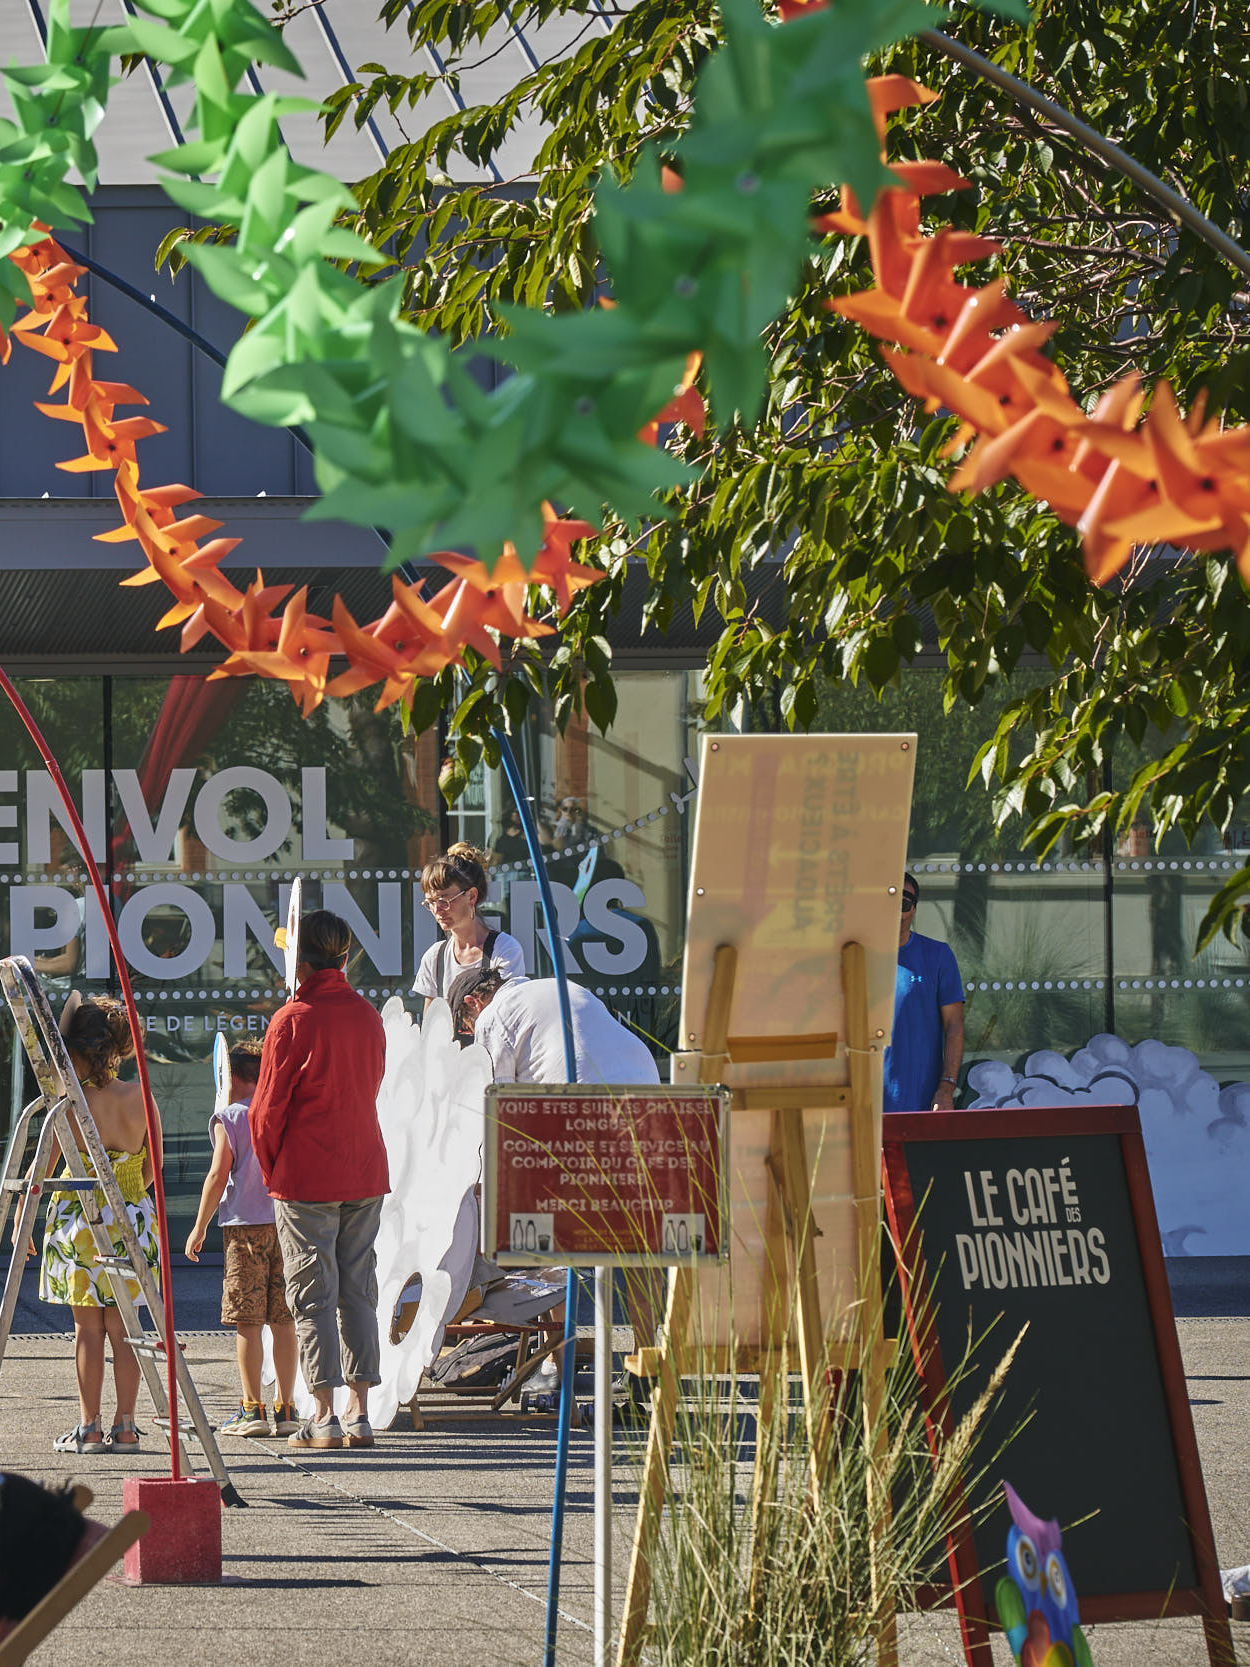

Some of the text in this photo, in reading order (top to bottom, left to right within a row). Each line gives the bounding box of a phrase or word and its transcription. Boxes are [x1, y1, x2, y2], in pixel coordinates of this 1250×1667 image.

[10, 878, 648, 979] PIONNIRS
[167, 1015, 194, 1032] DE
[497, 1101, 538, 1114] VOUS
[542, 1102, 578, 1115] ETES
[582, 1102, 612, 1115] SUR
[503, 1140, 595, 1153] COMMANDE
[599, 1140, 617, 1153] ET
[512, 1156, 596, 1169] COMPTOIR
[601, 1157, 622, 1169] DU
[964, 1156, 1079, 1227] LE CAFÉ
[536, 1199, 586, 1212] MERCI
[1065, 1207, 1082, 1223] DES
[955, 1227, 1111, 1290] PIONNIERS
